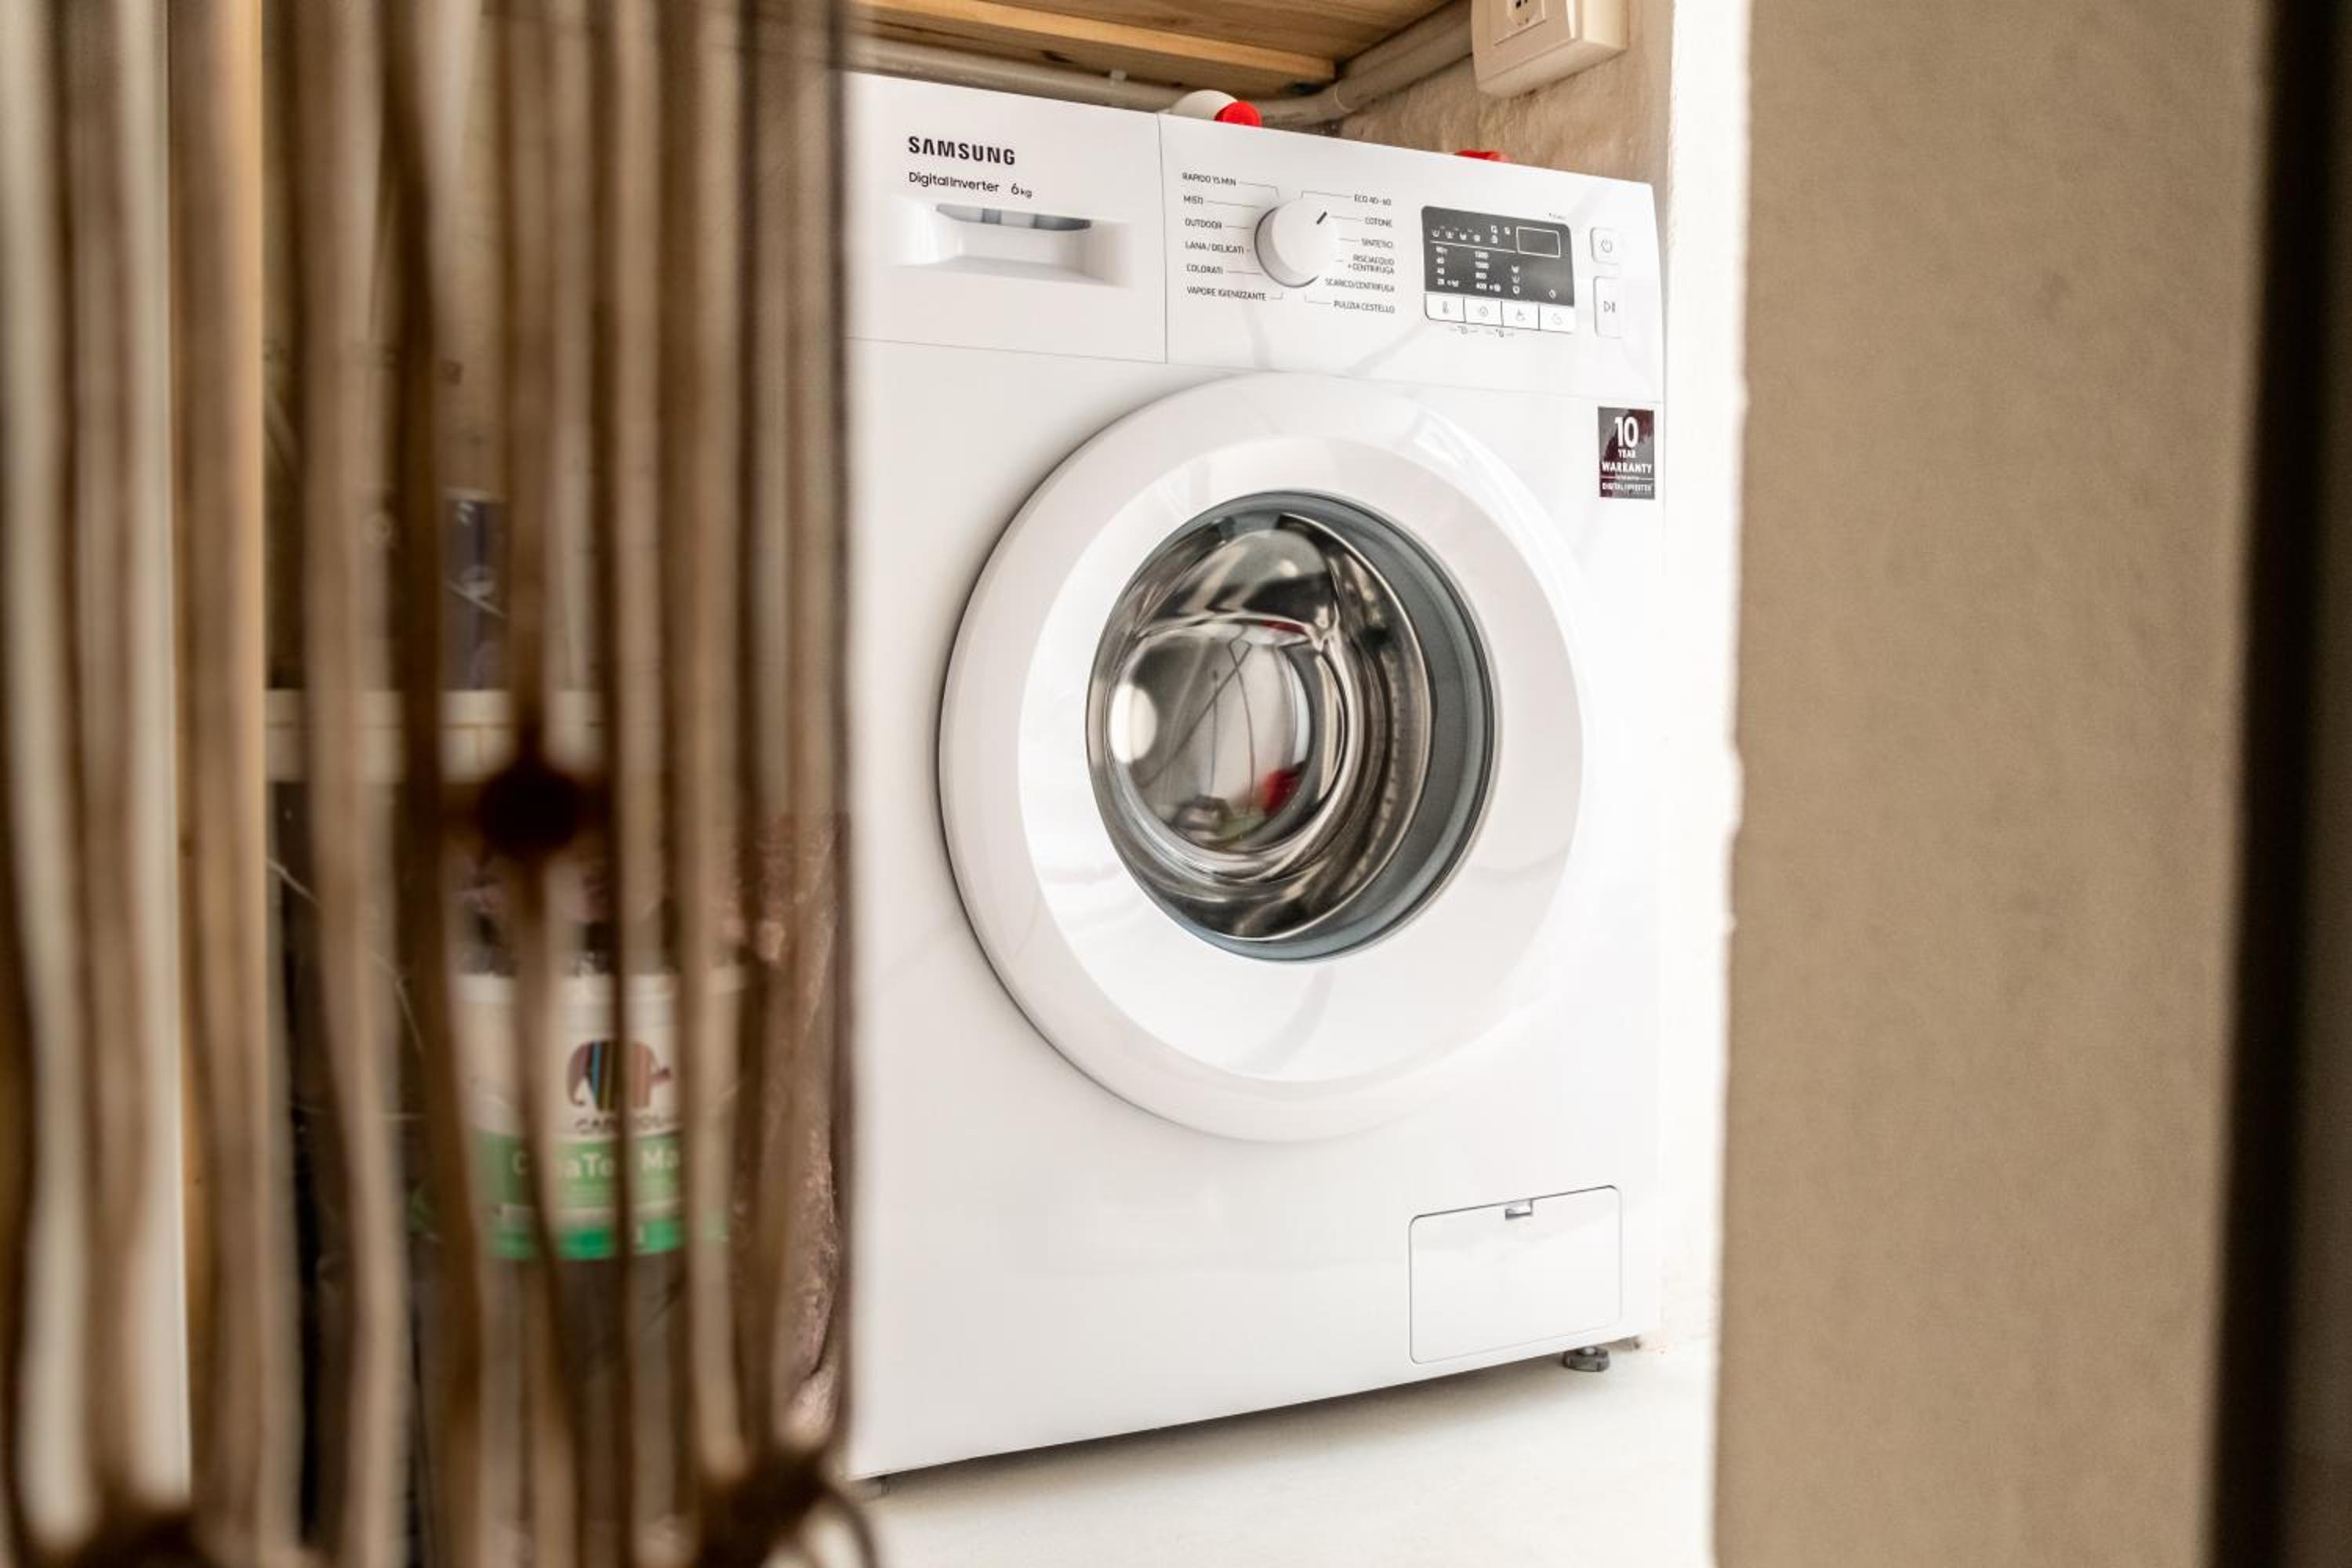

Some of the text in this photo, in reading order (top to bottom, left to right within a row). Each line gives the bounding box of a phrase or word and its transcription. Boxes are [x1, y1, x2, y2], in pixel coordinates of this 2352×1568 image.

[908, 136, 1015, 165] SAMSUNG
[1181, 172, 1211, 183] RAPIDO
[1221, 176, 1236, 186] MIN
[1354, 194, 1368, 203] ECO
[1185, 218, 1222, 230] OUTDOOR
[1185, 241, 1207, 251] LANA
[1211, 243, 1244, 255] DELICATI
[1186, 263, 1224, 274] COLORATI
[1187, 286, 1216, 296] VAPORE
[1361, 303, 1395, 314] CESTELLO
[1614, 416, 1639, 448] 10
[1617, 448, 1636, 459] YEAR
[1602, 461, 1652, 474] WARRANTY
